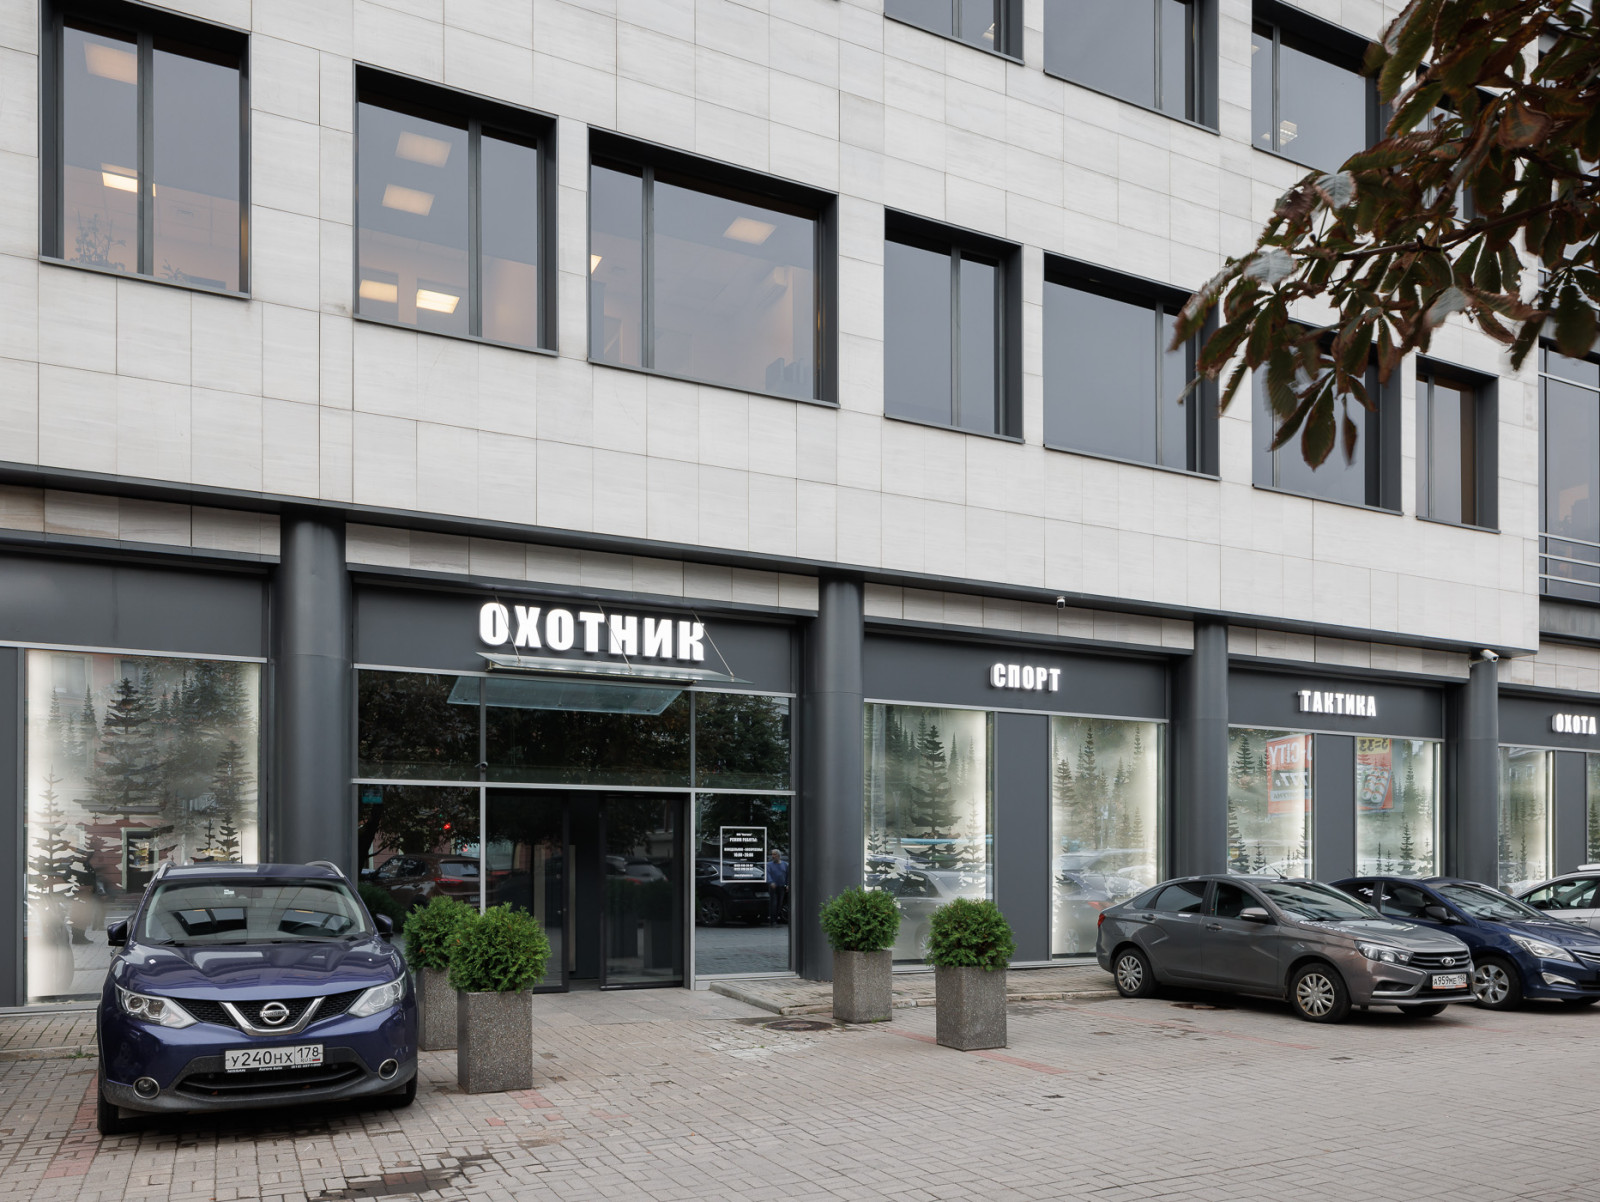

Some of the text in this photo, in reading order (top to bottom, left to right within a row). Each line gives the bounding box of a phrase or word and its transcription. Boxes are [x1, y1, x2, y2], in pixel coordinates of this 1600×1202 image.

[479, 602, 705, 661] ОХОТНИК
[990, 663, 1061, 691] СПОРТ
[1298, 690, 1377, 717] ТАКТИКА
[1552, 713, 1597, 735] ОХОТА
[231, 1046, 319, 1067] У240НХ 178
